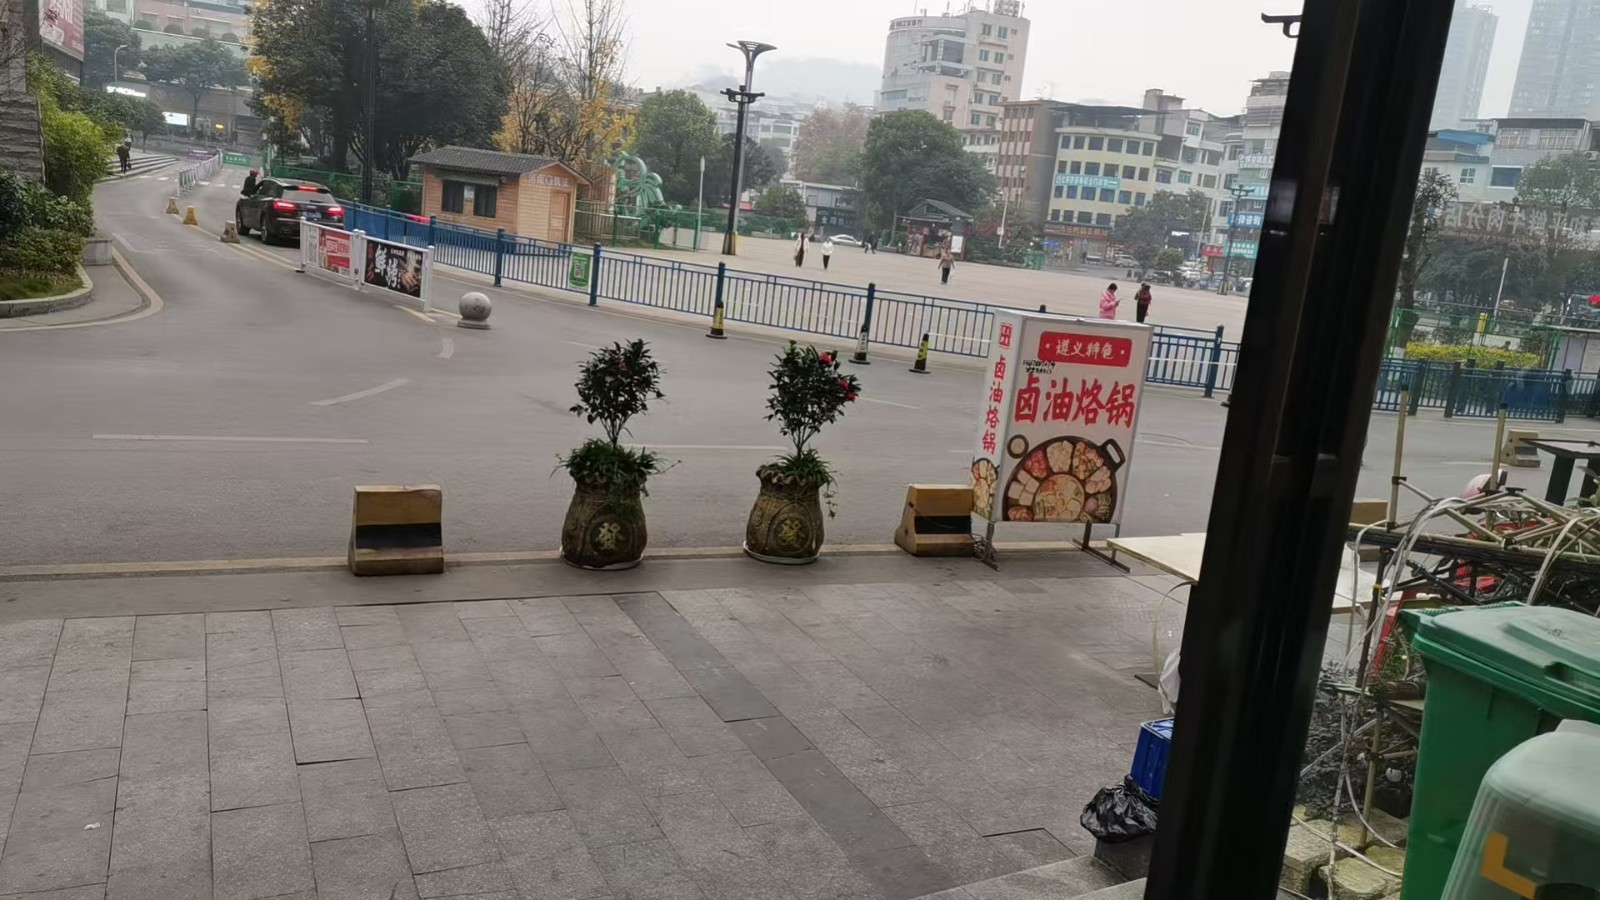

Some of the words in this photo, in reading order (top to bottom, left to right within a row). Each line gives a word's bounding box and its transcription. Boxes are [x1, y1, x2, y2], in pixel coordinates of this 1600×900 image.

[1055, 338, 1115, 360] 遵义特色
[981, 354, 1007, 455] 卤油烙锅
[1014, 372, 1136, 429] 卤油烙锅
